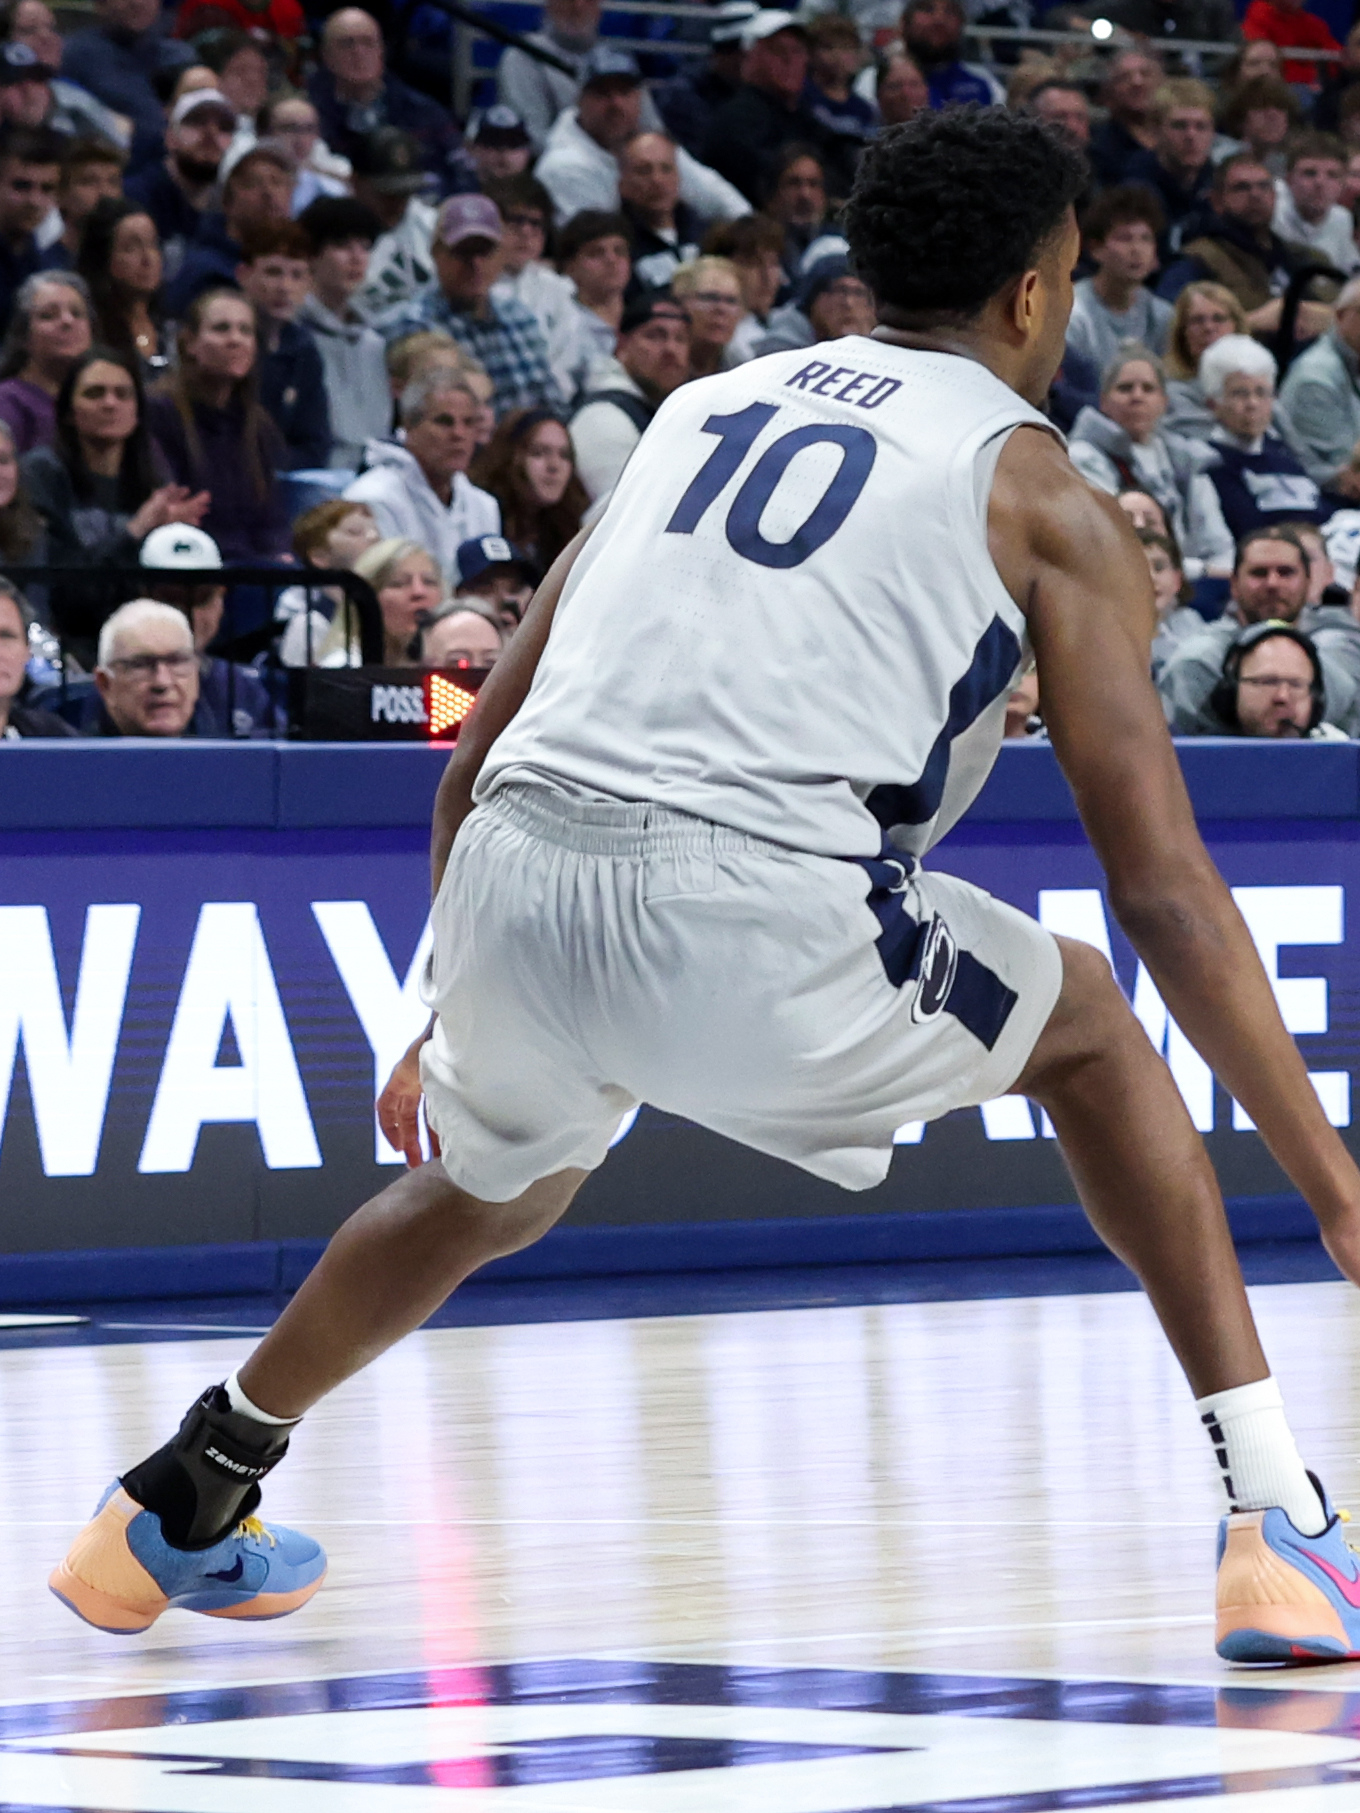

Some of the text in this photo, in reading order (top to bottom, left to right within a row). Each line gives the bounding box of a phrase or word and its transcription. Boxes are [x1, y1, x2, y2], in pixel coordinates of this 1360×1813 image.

[784, 360, 905, 410] REED
[663, 401, 878, 570] 10
[0, 900, 640, 1177] WAY
